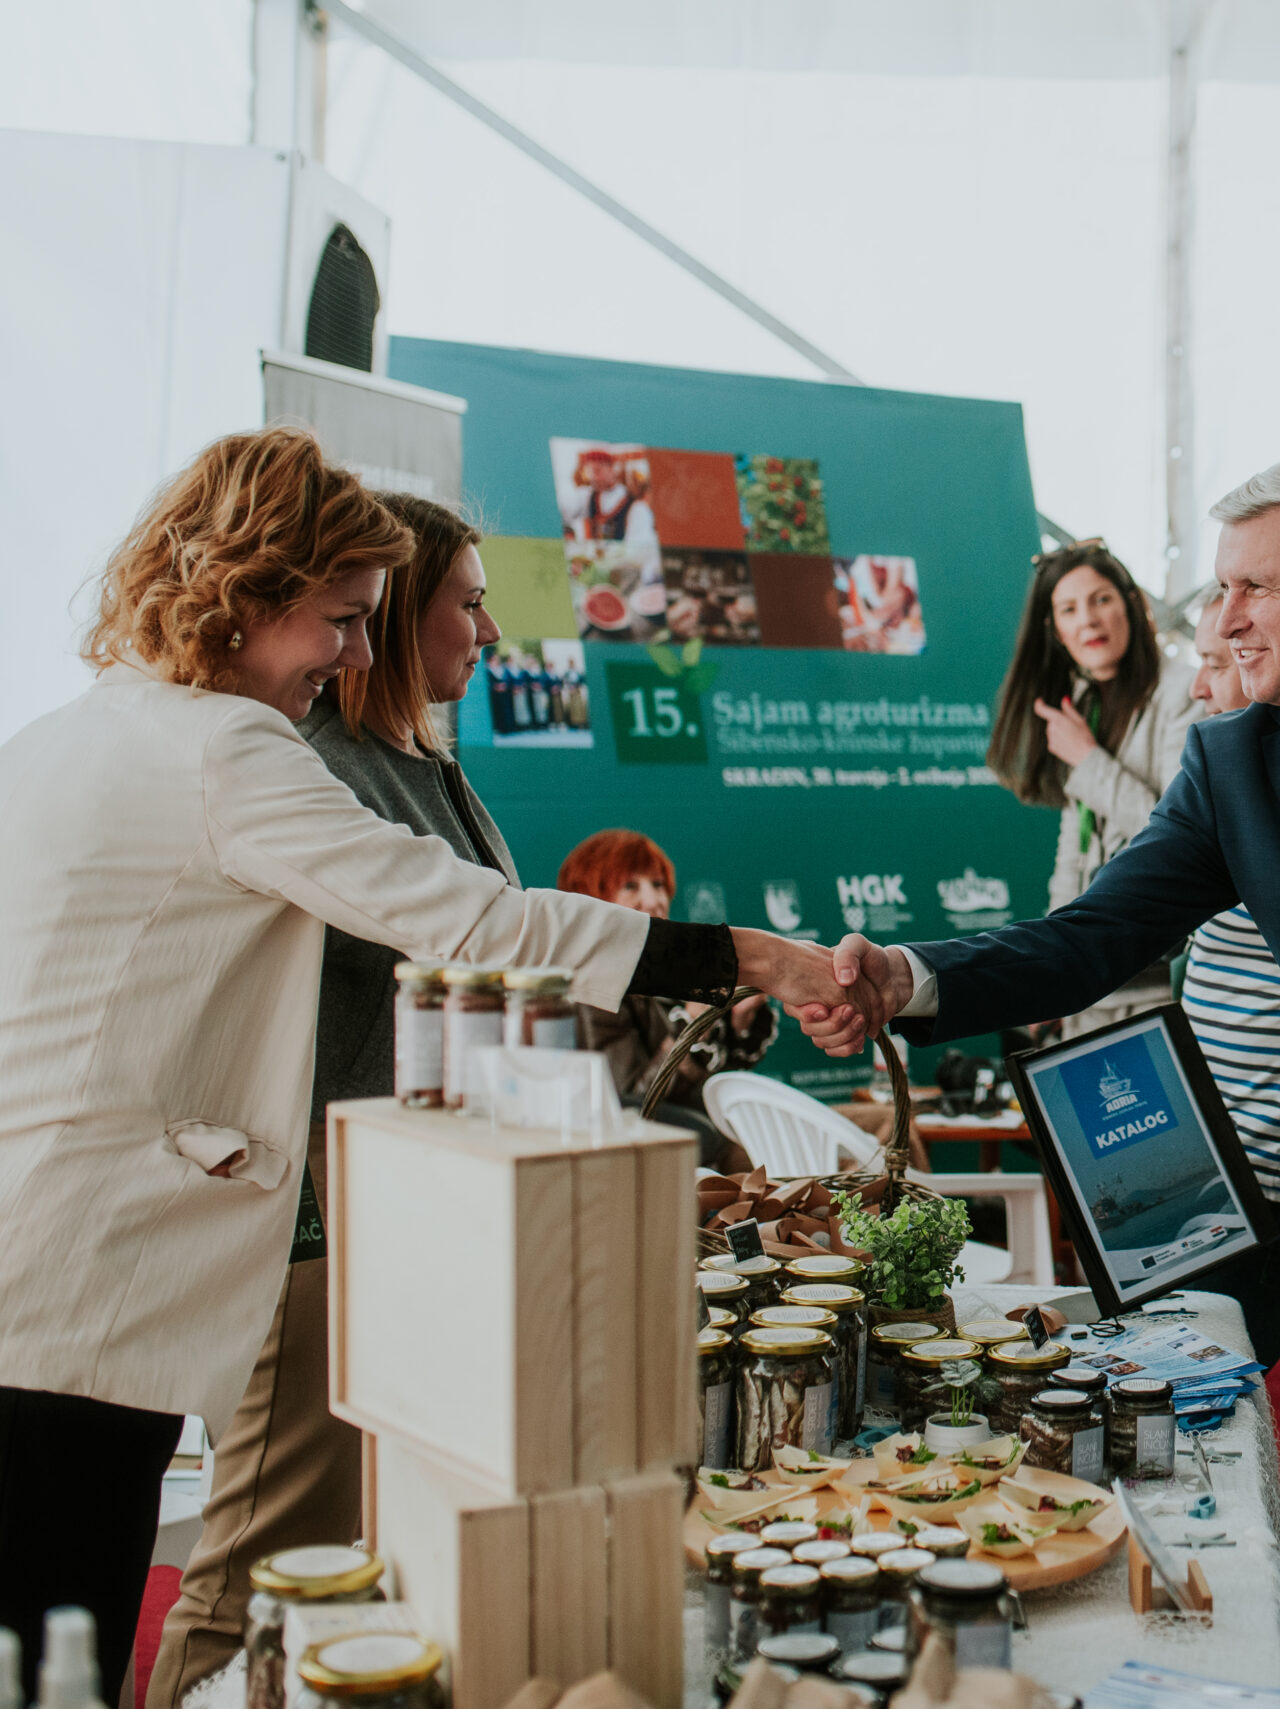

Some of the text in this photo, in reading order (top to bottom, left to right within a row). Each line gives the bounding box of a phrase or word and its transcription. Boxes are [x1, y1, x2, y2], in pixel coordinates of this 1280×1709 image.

[622, 686, 698, 737] 15.
[711, 691, 990, 733] Sajam agroturizma
[836, 874, 908, 906] HGK
[1105, 1093, 1138, 1113] ADRIA
[1095, 1110, 1168, 1149] KATALOG
